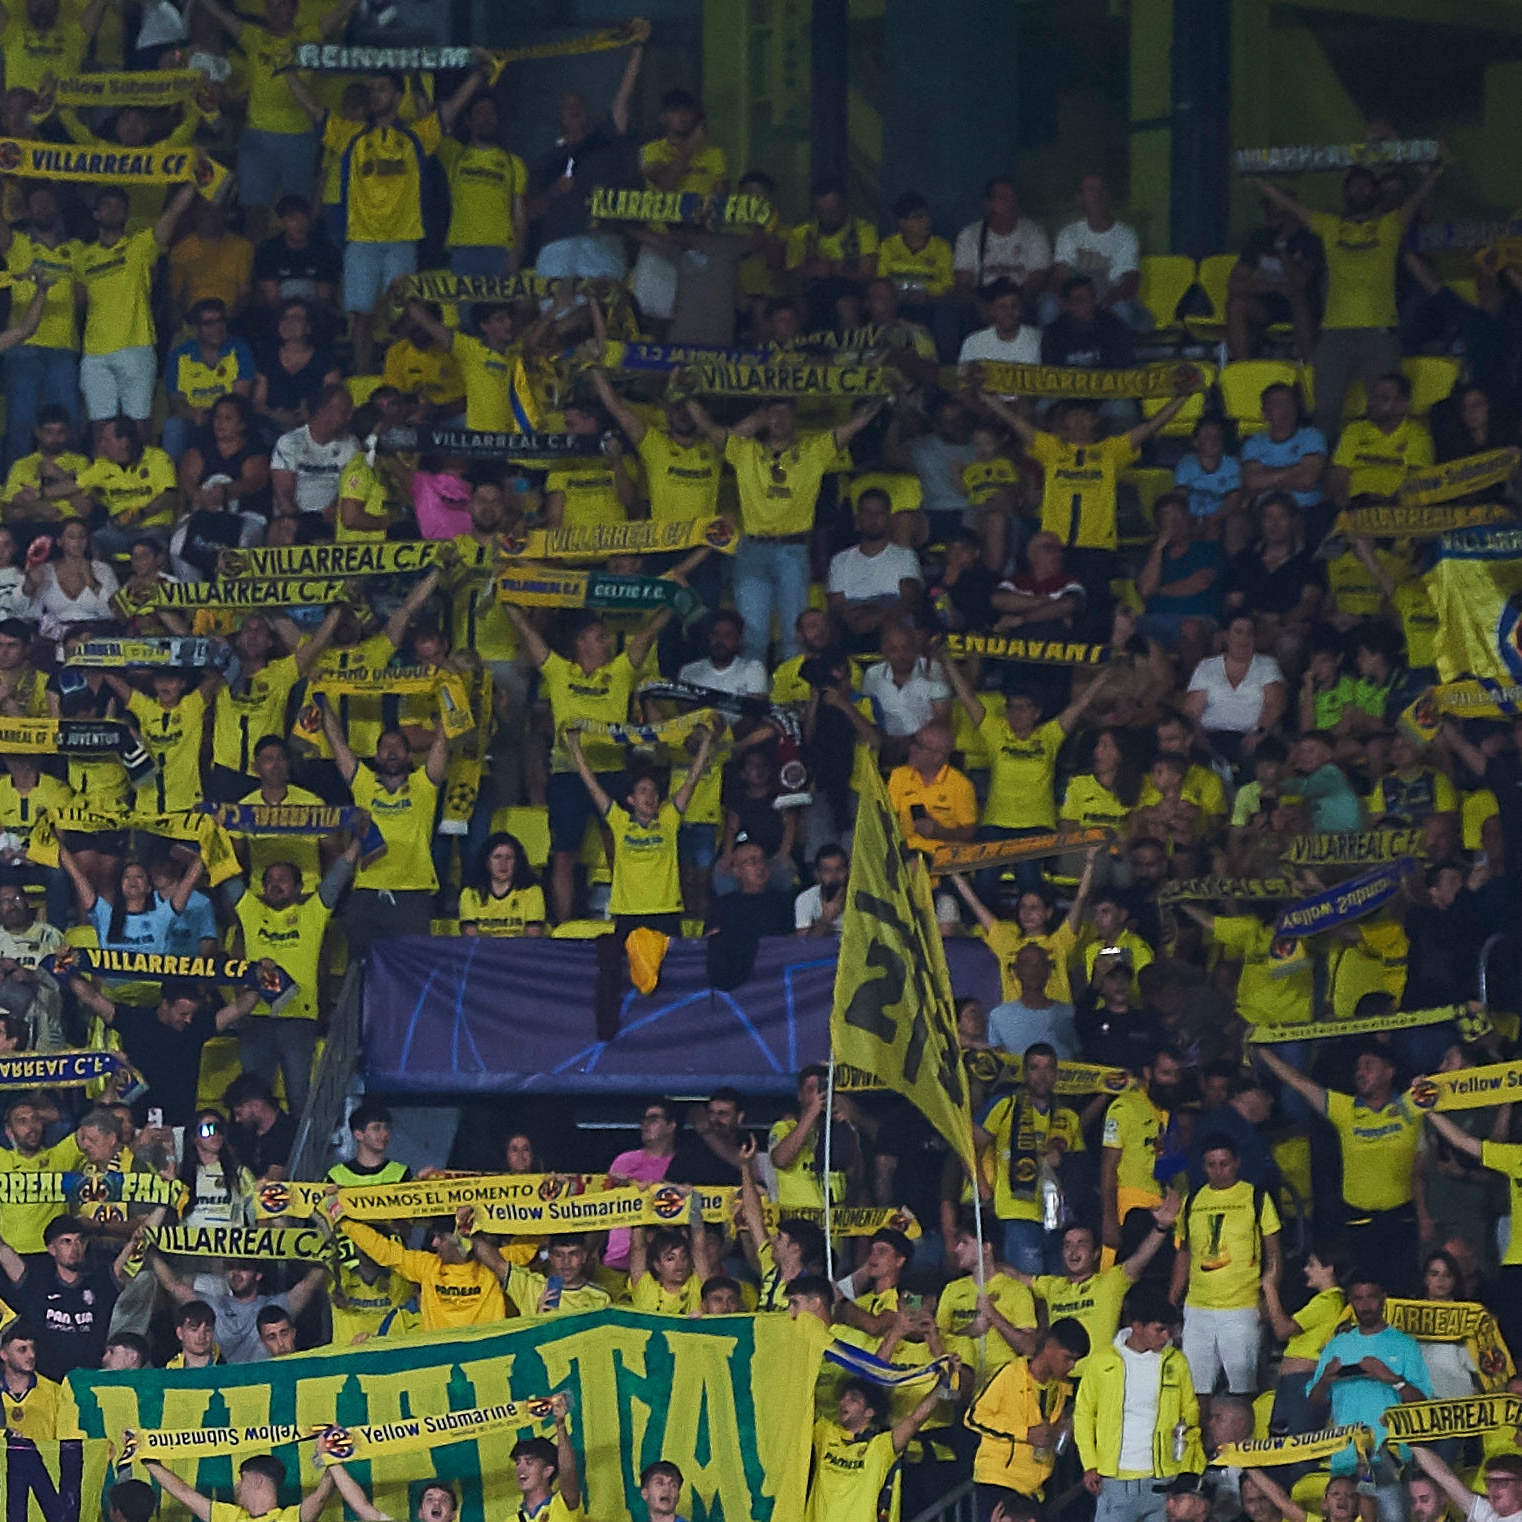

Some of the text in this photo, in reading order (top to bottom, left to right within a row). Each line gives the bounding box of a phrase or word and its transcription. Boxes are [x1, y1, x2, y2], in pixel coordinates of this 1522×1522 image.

[32, 150, 187, 175] VILLARREAL CF
[253, 549, 387, 575] VILLARREAL
[88, 950, 249, 979] VILLARREAL CF
[1449, 1076, 1502, 1094] Yellow
[348, 1185, 532, 1209] VIVAMOS EL MOMENTO
[484, 1196, 641, 1220] Yellow Submarine
[157, 1229, 285, 1257] VILLARREAL
[359, 1402, 518, 1445] Yellow Submarine
[1388, 1400, 1500, 1436] VILLARREAL
[148, 1426, 301, 1448] Yellow Submarine
